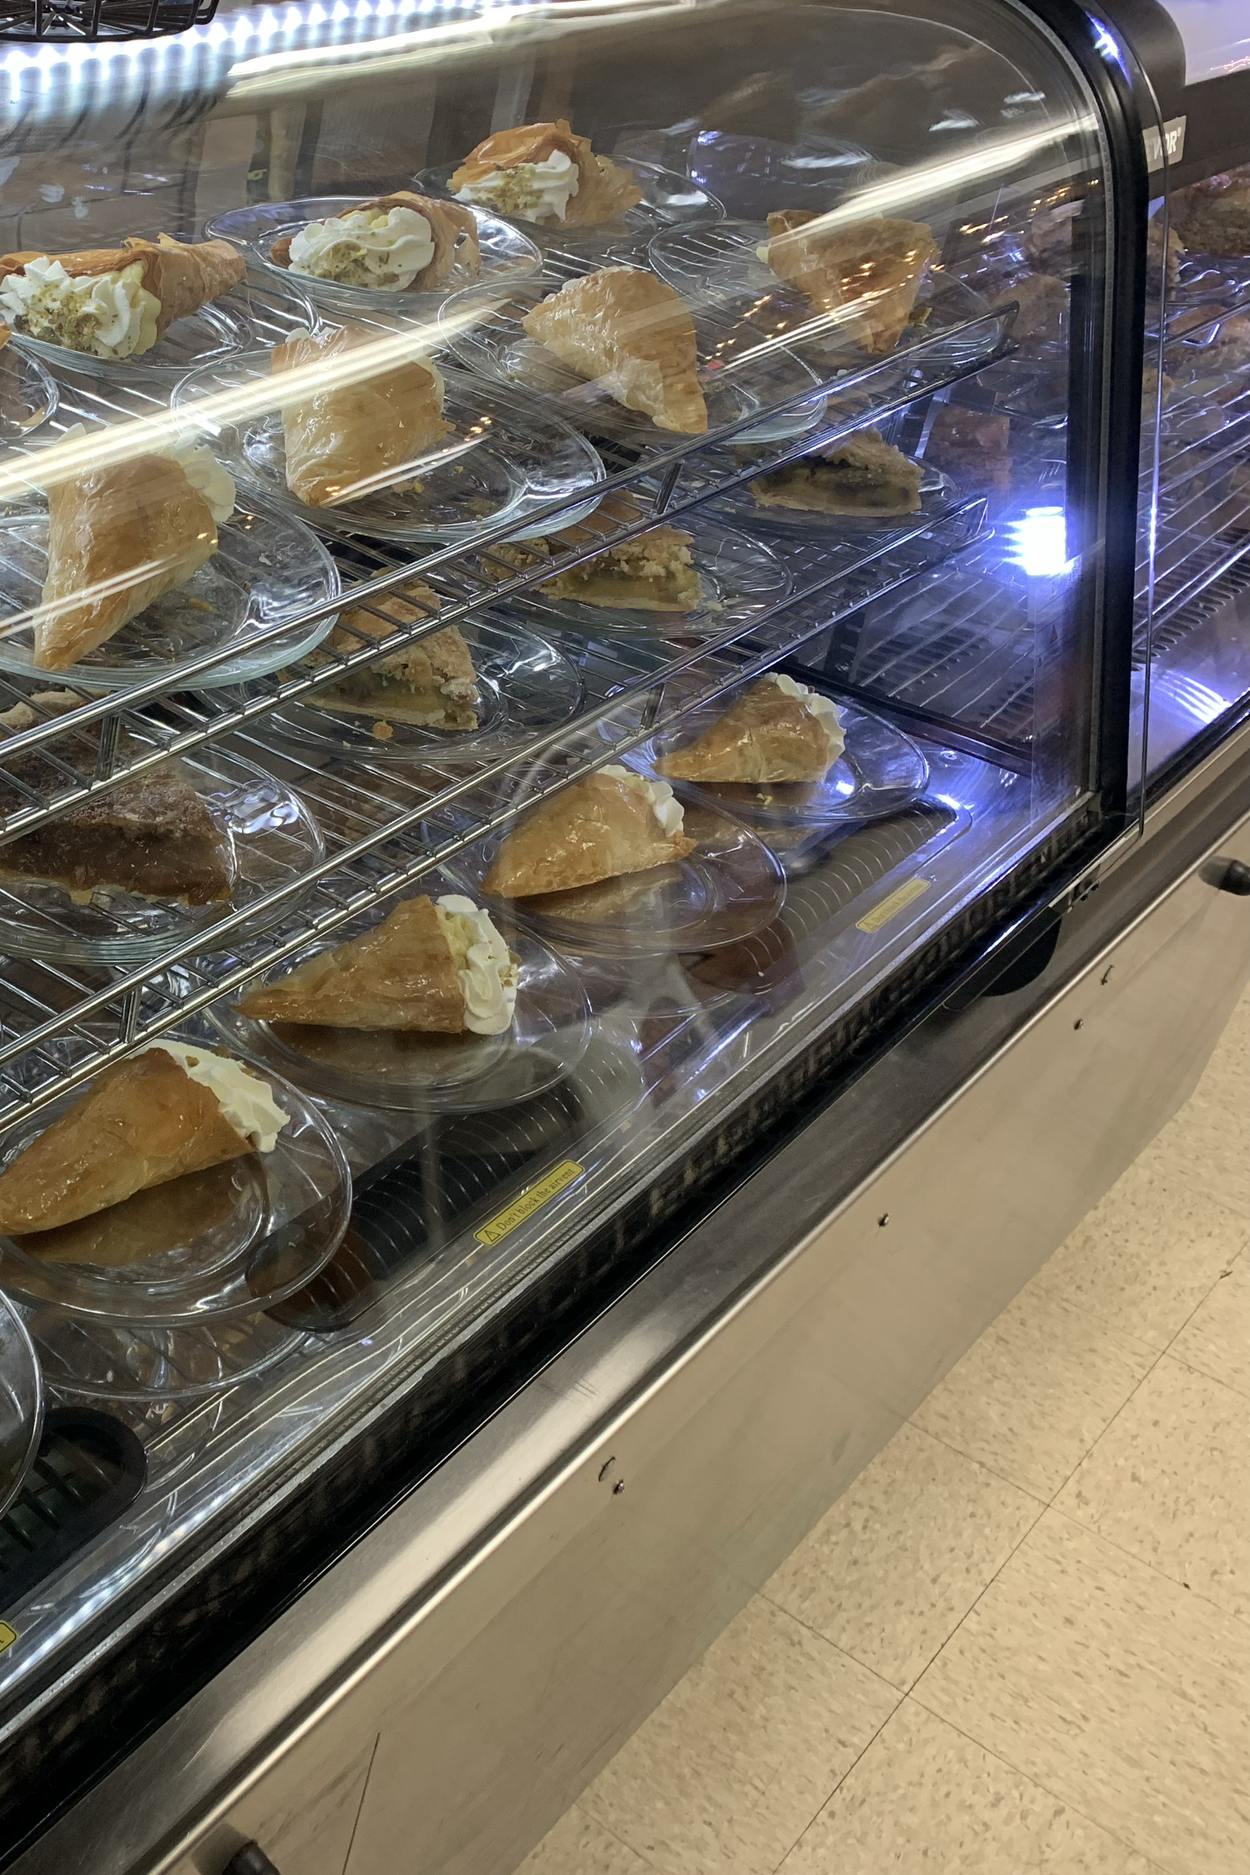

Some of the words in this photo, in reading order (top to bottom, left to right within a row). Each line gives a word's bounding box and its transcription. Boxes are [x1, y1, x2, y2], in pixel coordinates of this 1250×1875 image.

[497, 1211, 519, 1231] Don't
[517, 1197, 539, 1215] block
[537, 1187, 551, 1199] the
[550, 1169, 574, 1189] airvent
